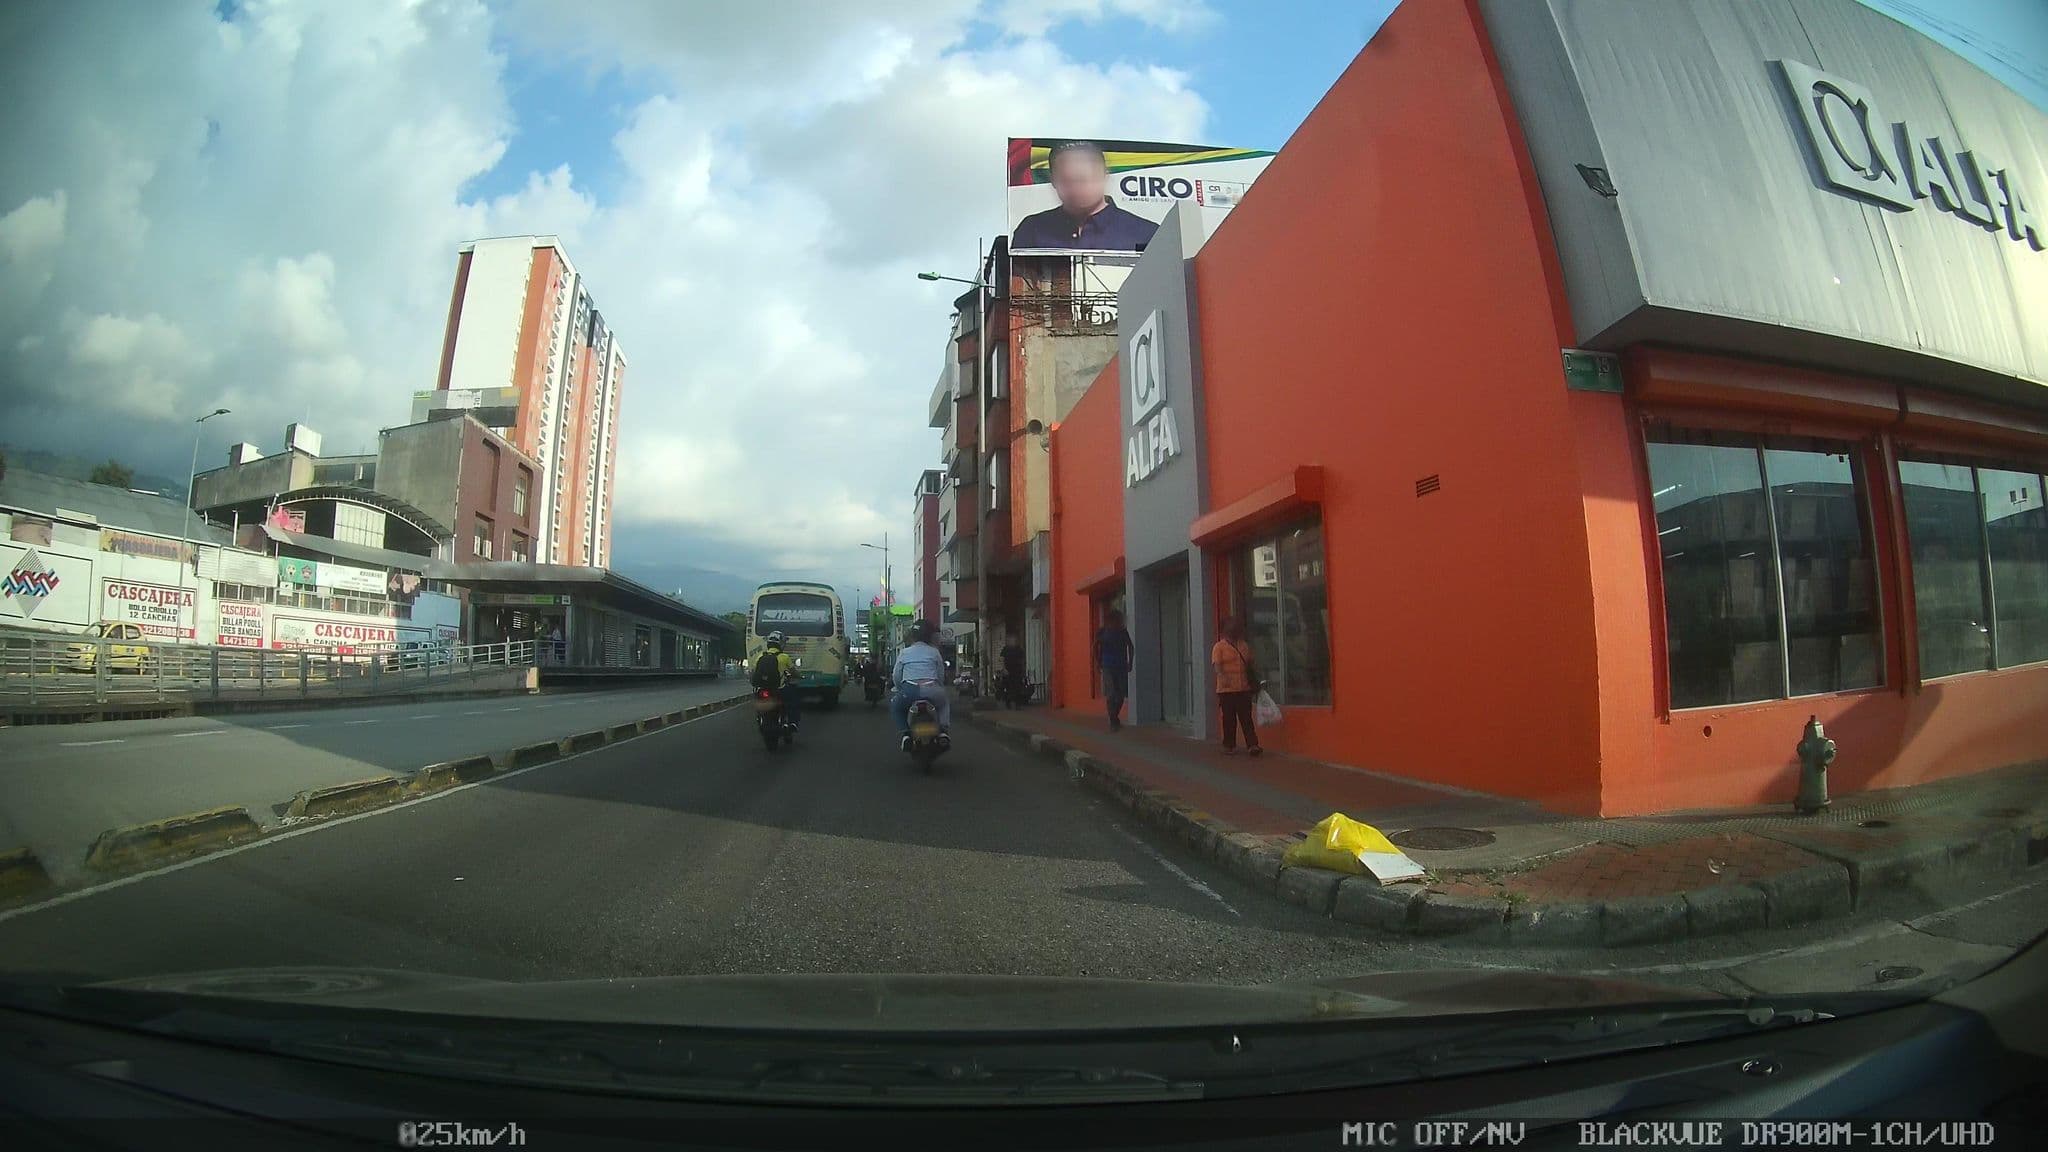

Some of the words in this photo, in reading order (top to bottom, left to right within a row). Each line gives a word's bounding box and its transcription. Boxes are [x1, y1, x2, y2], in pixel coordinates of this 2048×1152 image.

[1120, 175, 1193, 199] CIRO
[1895, 120, 2047, 252] ALFA
[1126, 407, 1179, 489] ALFA
[108, 584, 193, 607] CASCAJERA
[128, 604, 147, 612] BOLO
[148, 606, 178, 616] CRIOLLO
[129, 611, 139, 619] 12
[142, 612, 177, 623] CANCHAS
[220, 604, 261, 619] CASCAJERA
[222, 617, 242, 626] BILLAR
[220, 625, 236, 635] TRES
[237, 627, 261, 637] BANDAS
[315, 624, 396, 642] CASCAJERA
